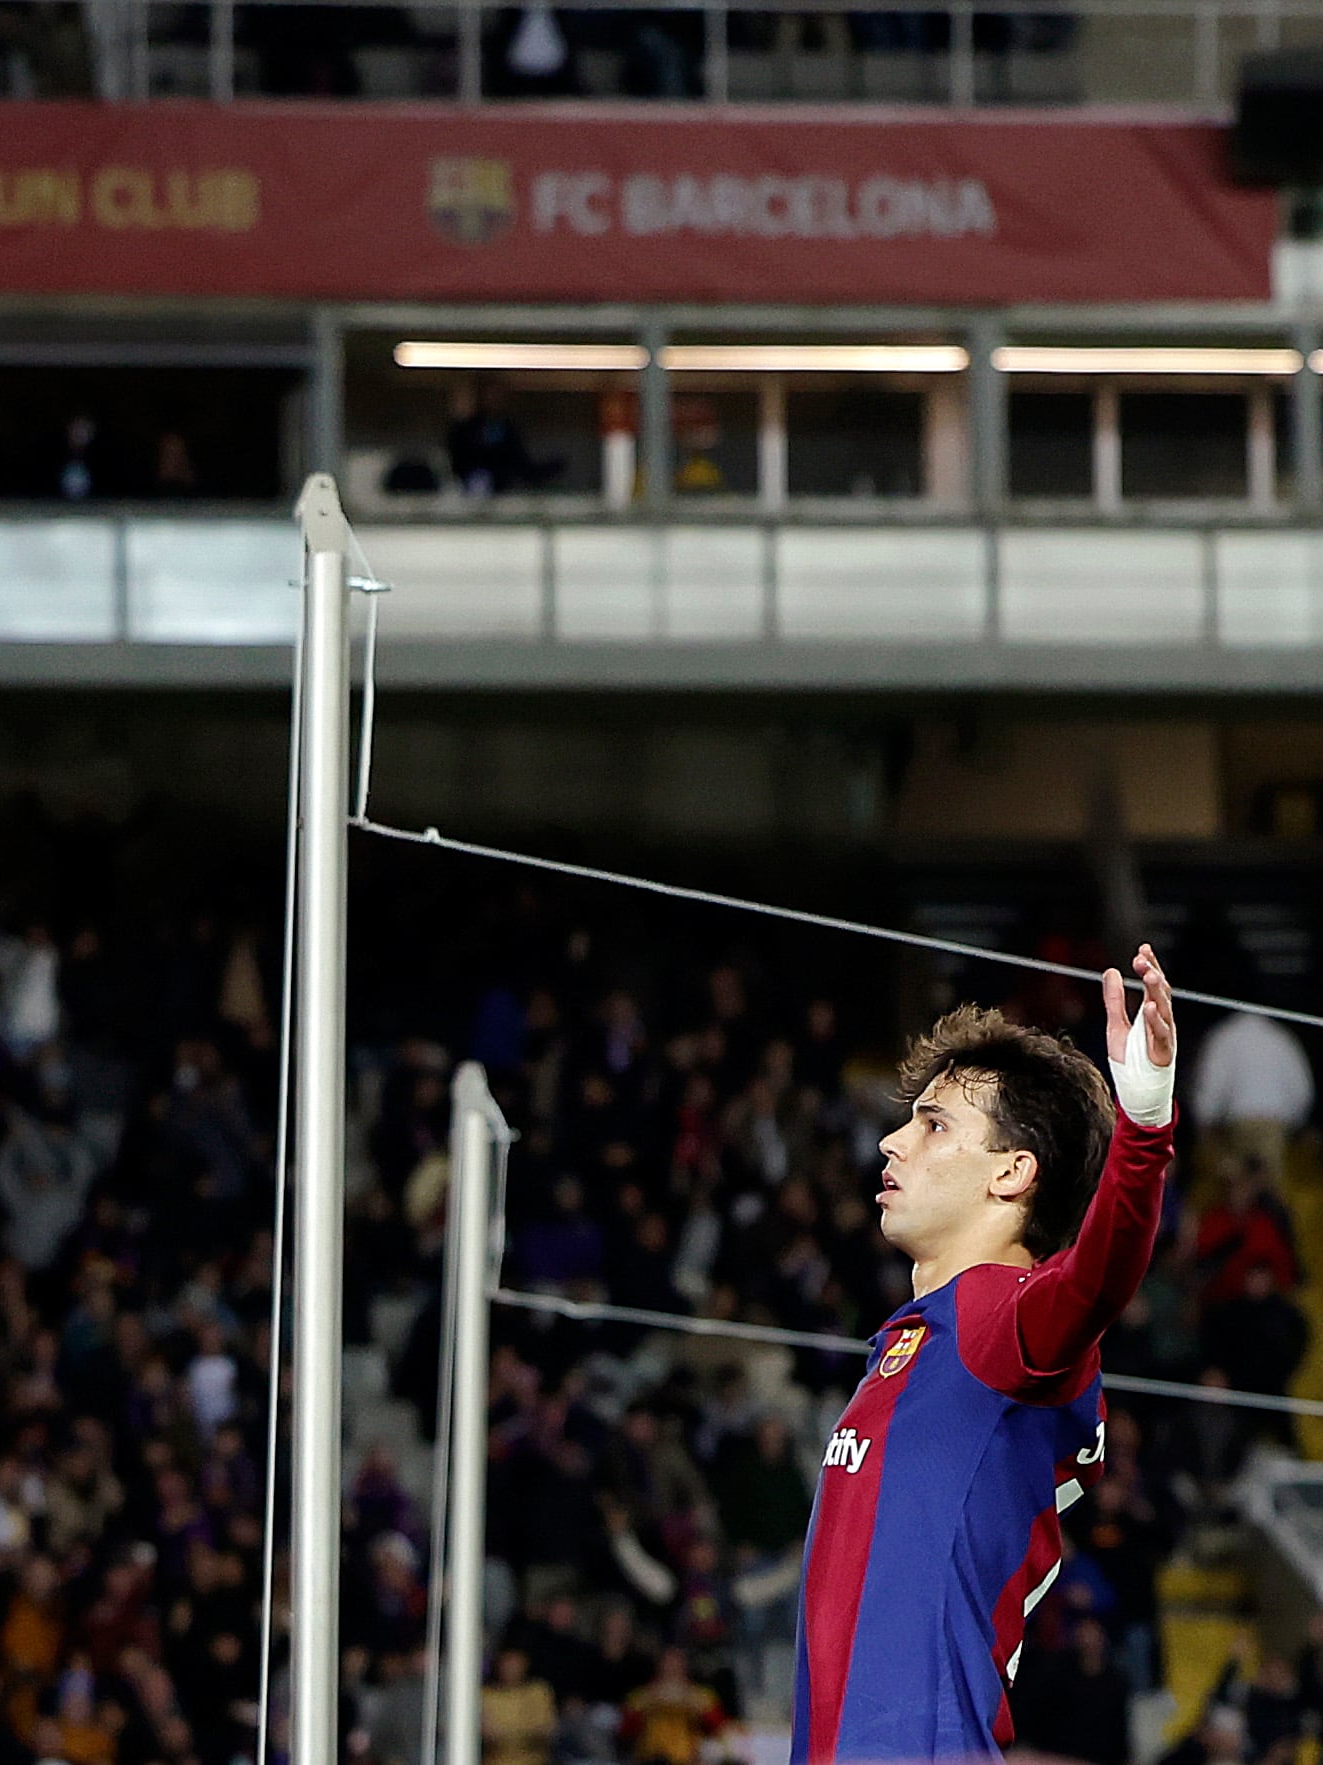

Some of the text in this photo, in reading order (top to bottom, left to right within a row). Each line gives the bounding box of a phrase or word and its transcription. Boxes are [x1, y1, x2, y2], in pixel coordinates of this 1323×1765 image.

[92, 166, 260, 232] CLUB
[532, 173, 995, 239] FC BARCELONA
[822, 1428, 872, 1474] tify
